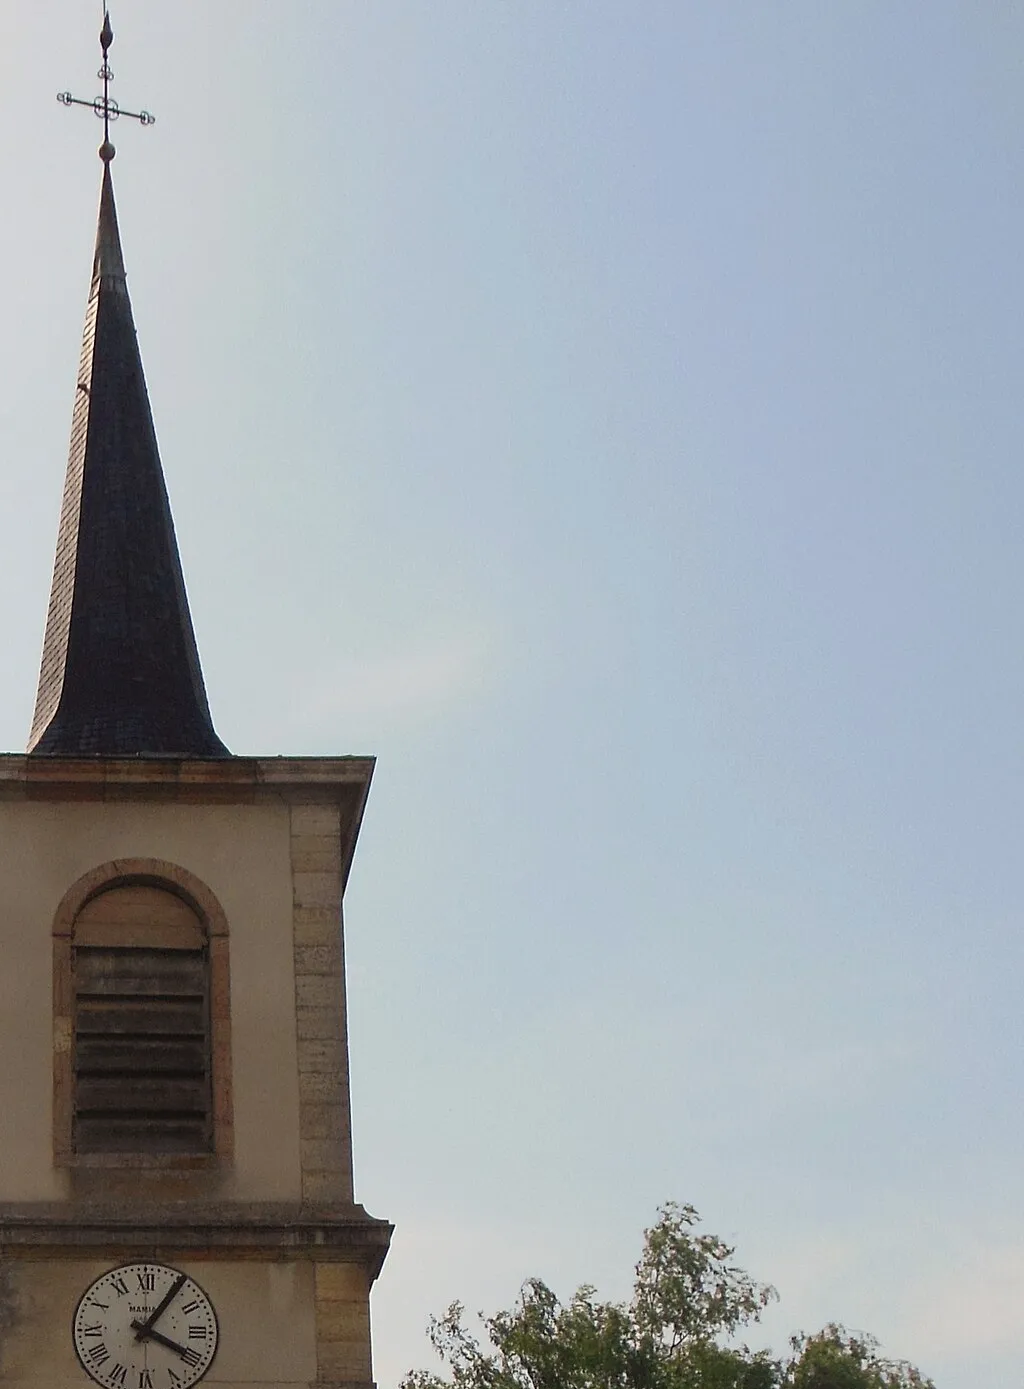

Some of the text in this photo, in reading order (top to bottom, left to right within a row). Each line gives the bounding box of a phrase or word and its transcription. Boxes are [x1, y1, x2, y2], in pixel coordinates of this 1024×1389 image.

[111, 1278, 129, 1297] XI
[137, 1274, 155, 1291] XII
[91, 1299, 109, 1313] X
[182, 1301, 200, 1315] II
[85, 1324, 102, 1337] IX
[189, 1326, 206, 1339] III
[108, 1363, 128, 1385] VII
